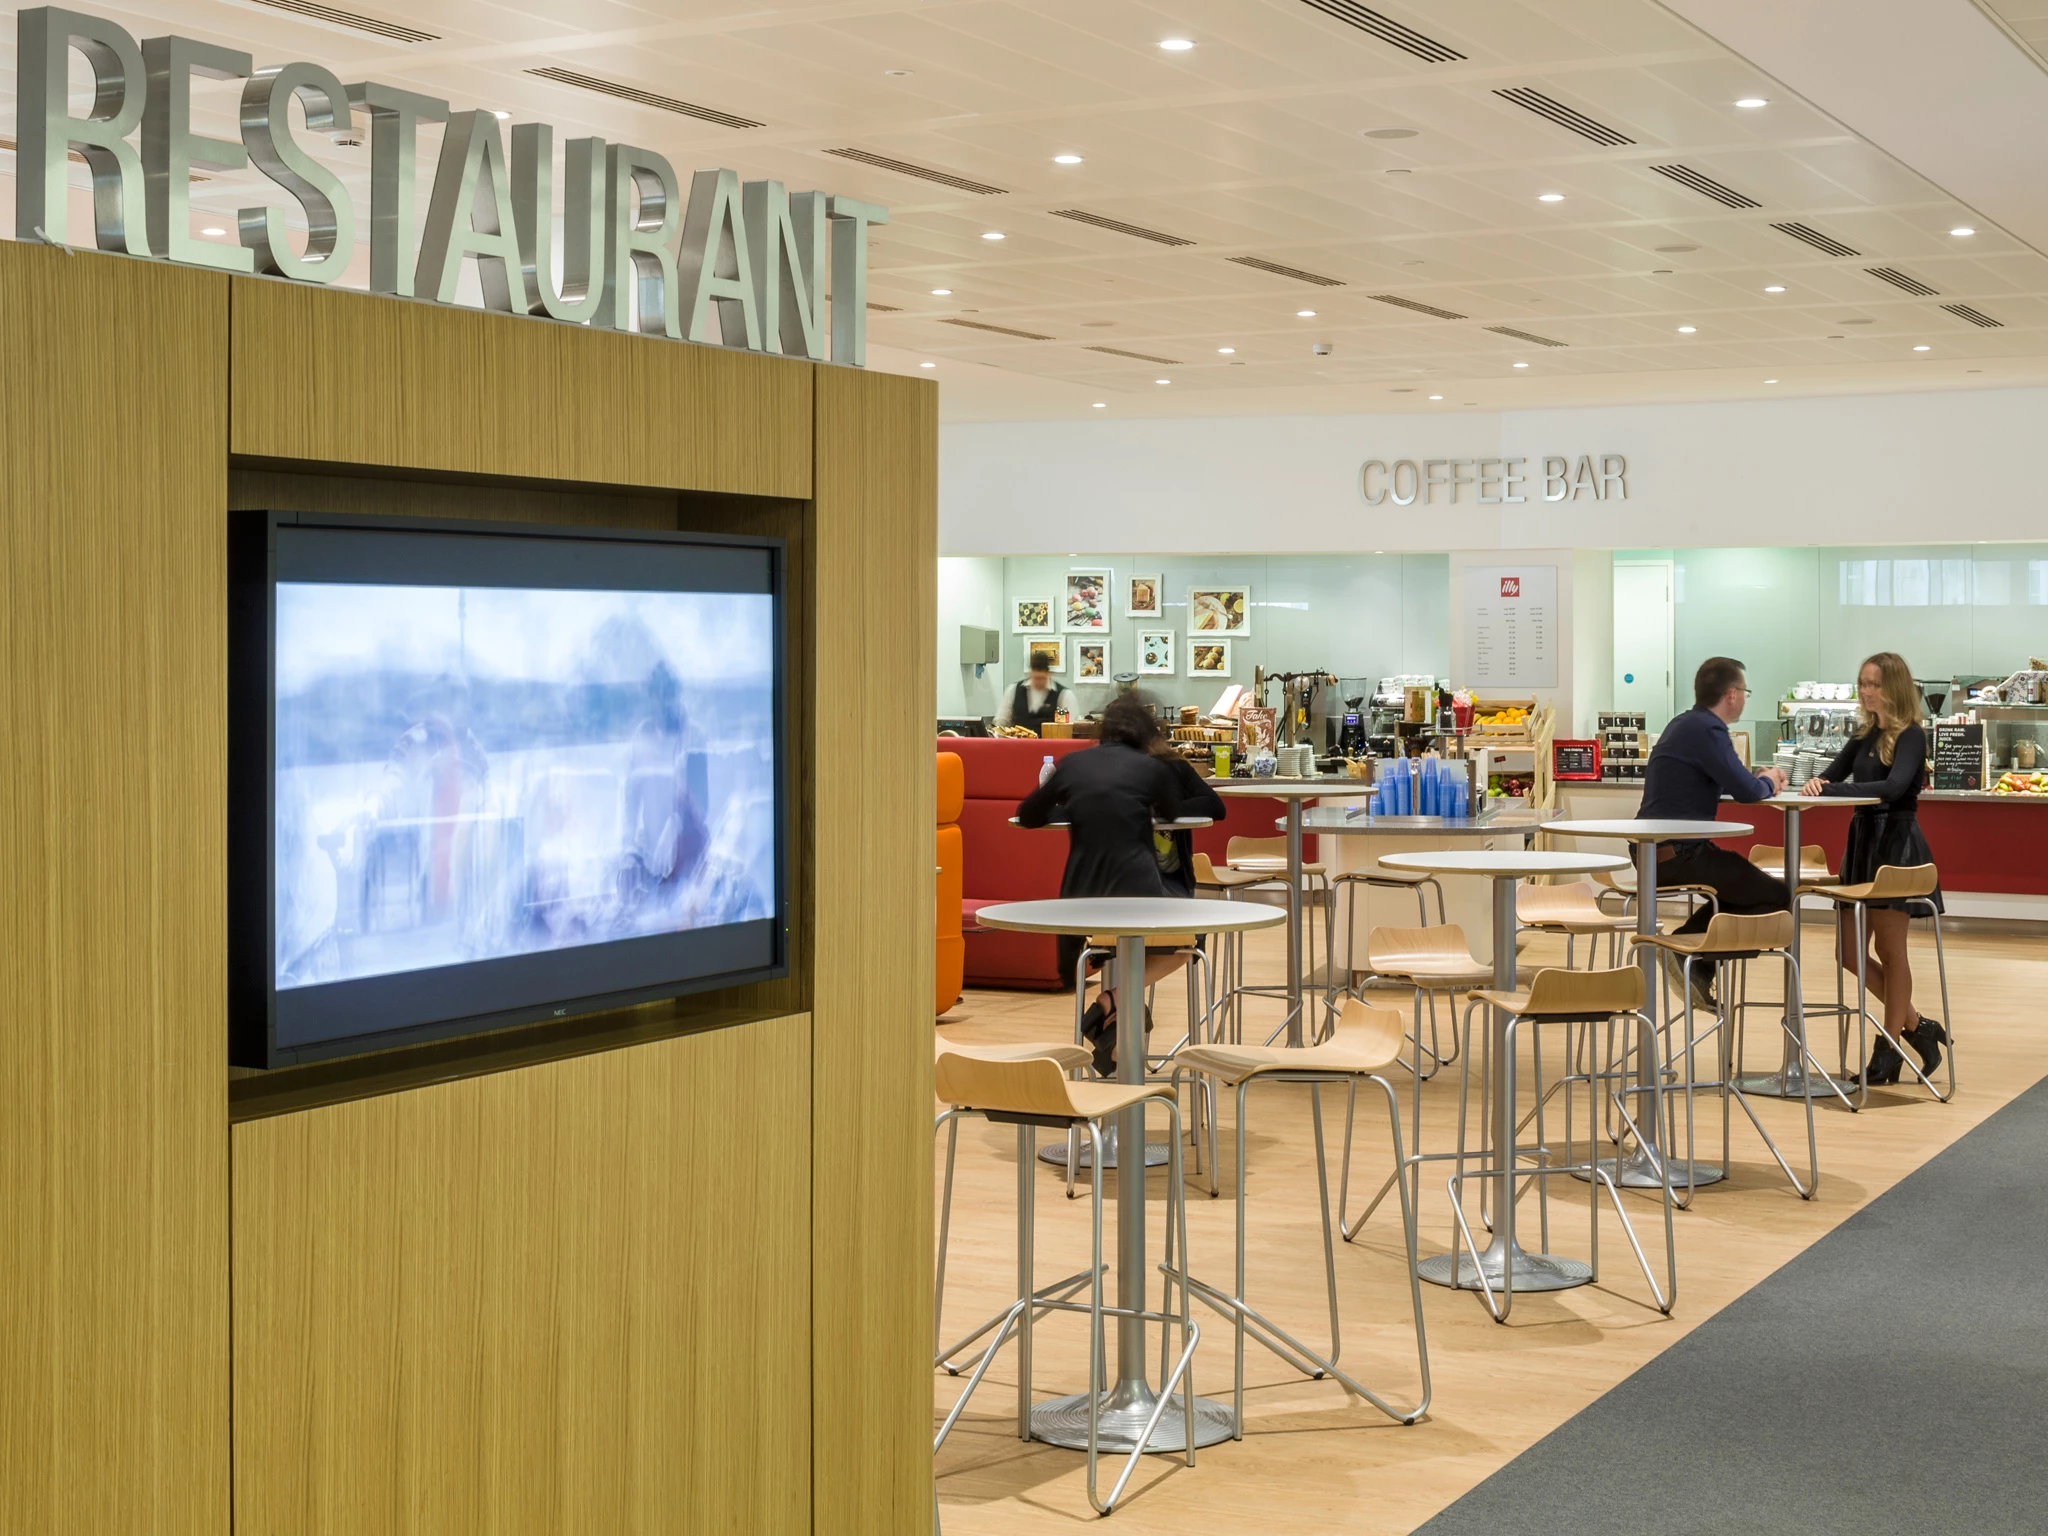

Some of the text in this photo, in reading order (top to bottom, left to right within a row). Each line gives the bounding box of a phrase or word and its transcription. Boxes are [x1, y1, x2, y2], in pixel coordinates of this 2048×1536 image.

[15, 5, 890, 368] RESTAURANT
[1357, 454, 1627, 506] COFFEE BAR
[1501, 579, 1519, 596] illy
[1246, 710, 1267, 720] Take
[553, 1008, 566, 1016] NEC
